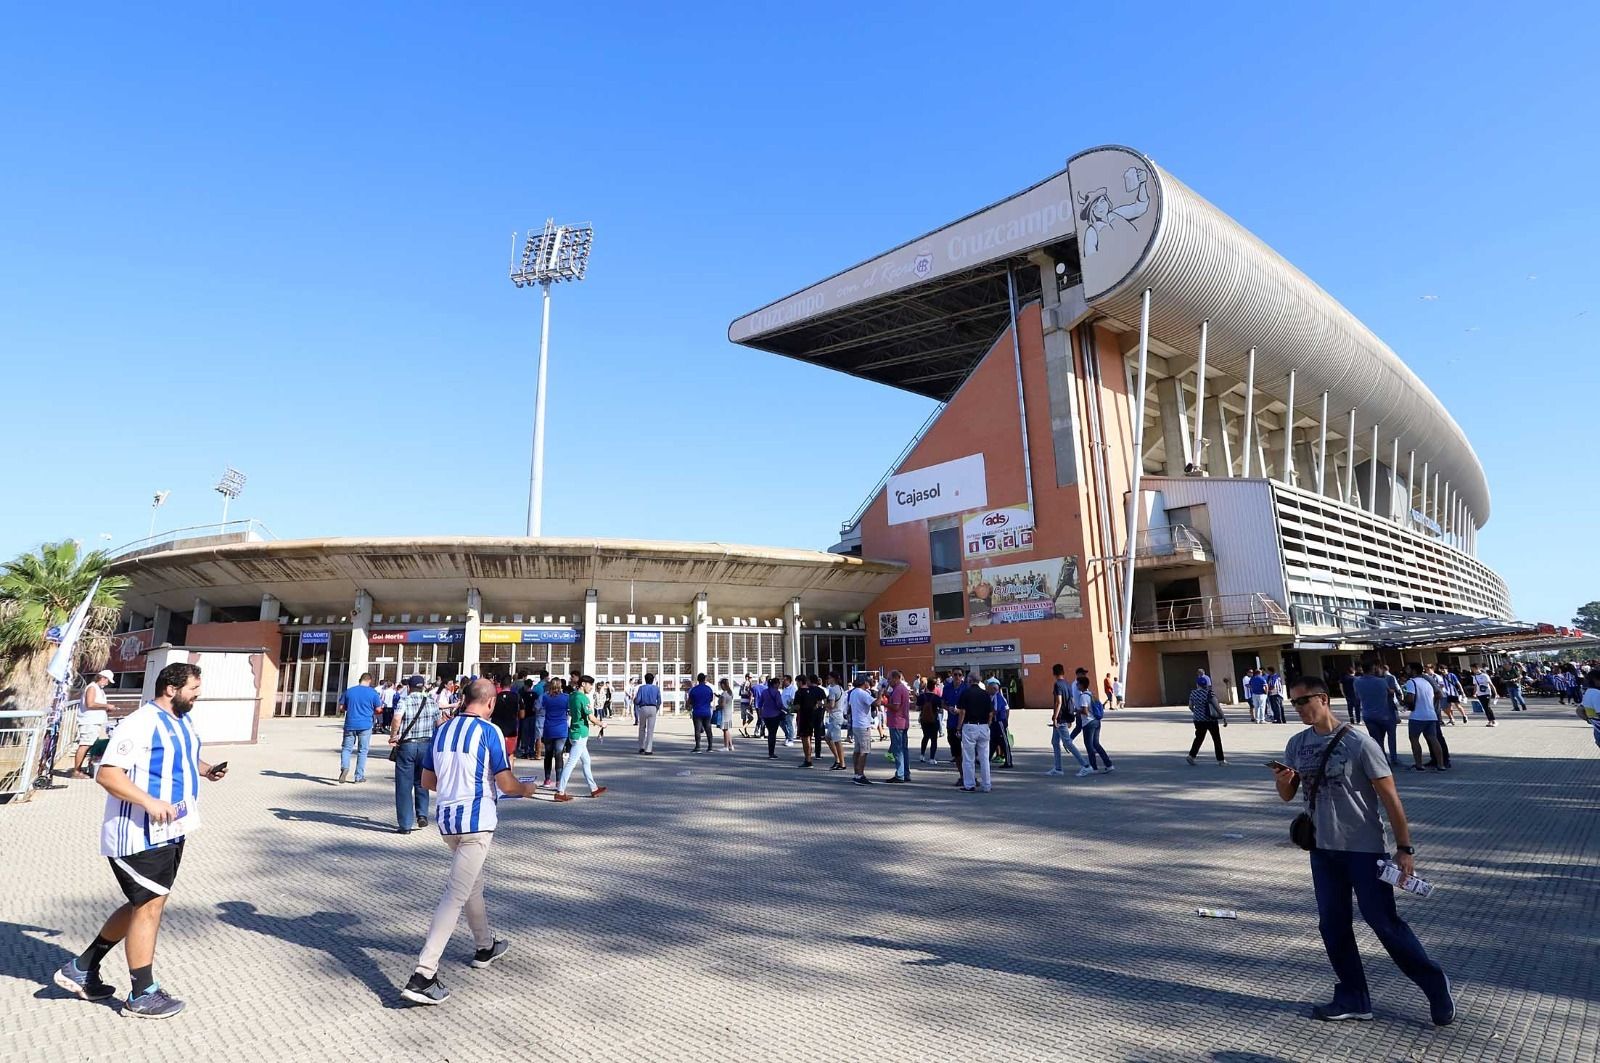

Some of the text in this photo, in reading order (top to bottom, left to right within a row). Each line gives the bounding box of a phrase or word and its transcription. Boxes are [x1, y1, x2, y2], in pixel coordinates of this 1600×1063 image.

[950, 199, 1072, 261] Cruzcampo
[750, 291, 824, 332] Cruzcampo
[896, 483, 941, 507] Cajasol
[985, 512, 1006, 527] ads
